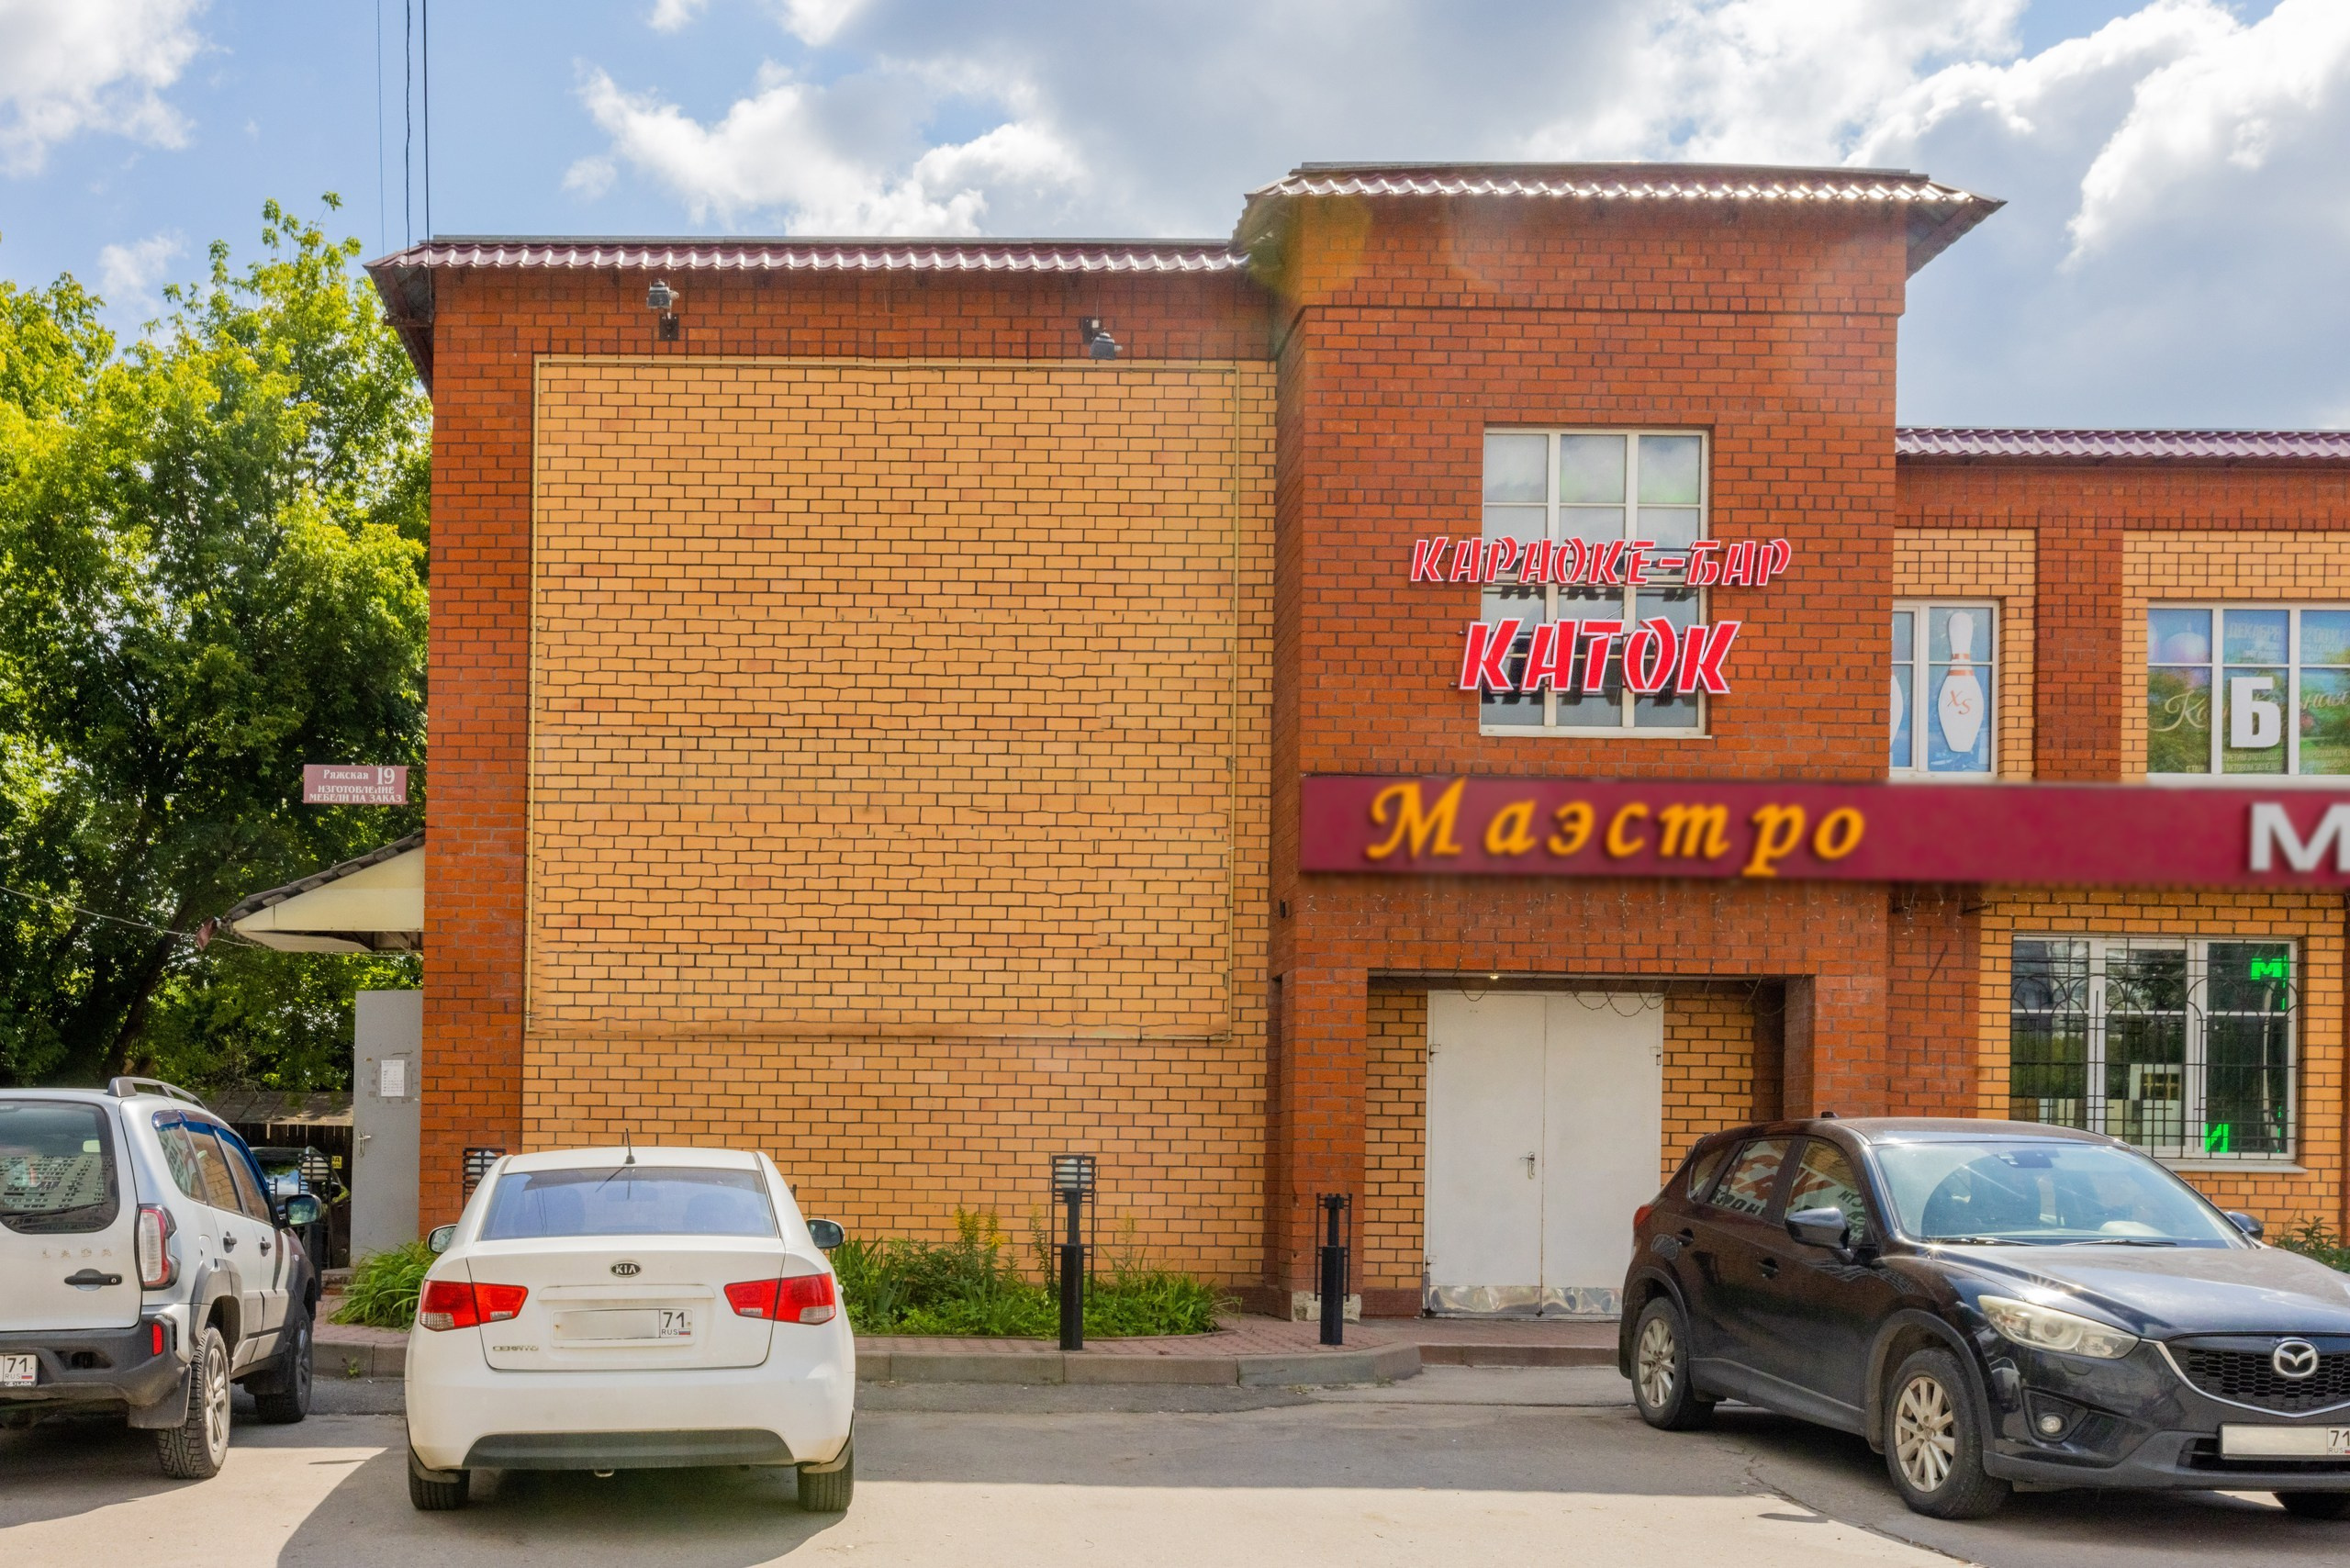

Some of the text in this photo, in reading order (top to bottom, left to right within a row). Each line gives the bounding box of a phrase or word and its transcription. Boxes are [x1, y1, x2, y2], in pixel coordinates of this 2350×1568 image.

[1410, 536, 1792, 587] КАРАОКЕ-БАР
[1458, 617, 1742, 695] КАТОК
[2231, 677, 2281, 748] Б
[323, 767, 396, 785] Ряжская 19
[308, 793, 402, 803] МЕБЕЛИ НА ЗАКАЗ
[318, 785, 395, 794] ИЗГОТОВЛЕНИЕ
[1366, 777, 1865, 877] Маэстро
[615, 1264, 636, 1274] KIA
[663, 1311, 685, 1328] 71
[7, 1357, 28, 1373] 71
[2330, 1429, 2350, 1447] 71
